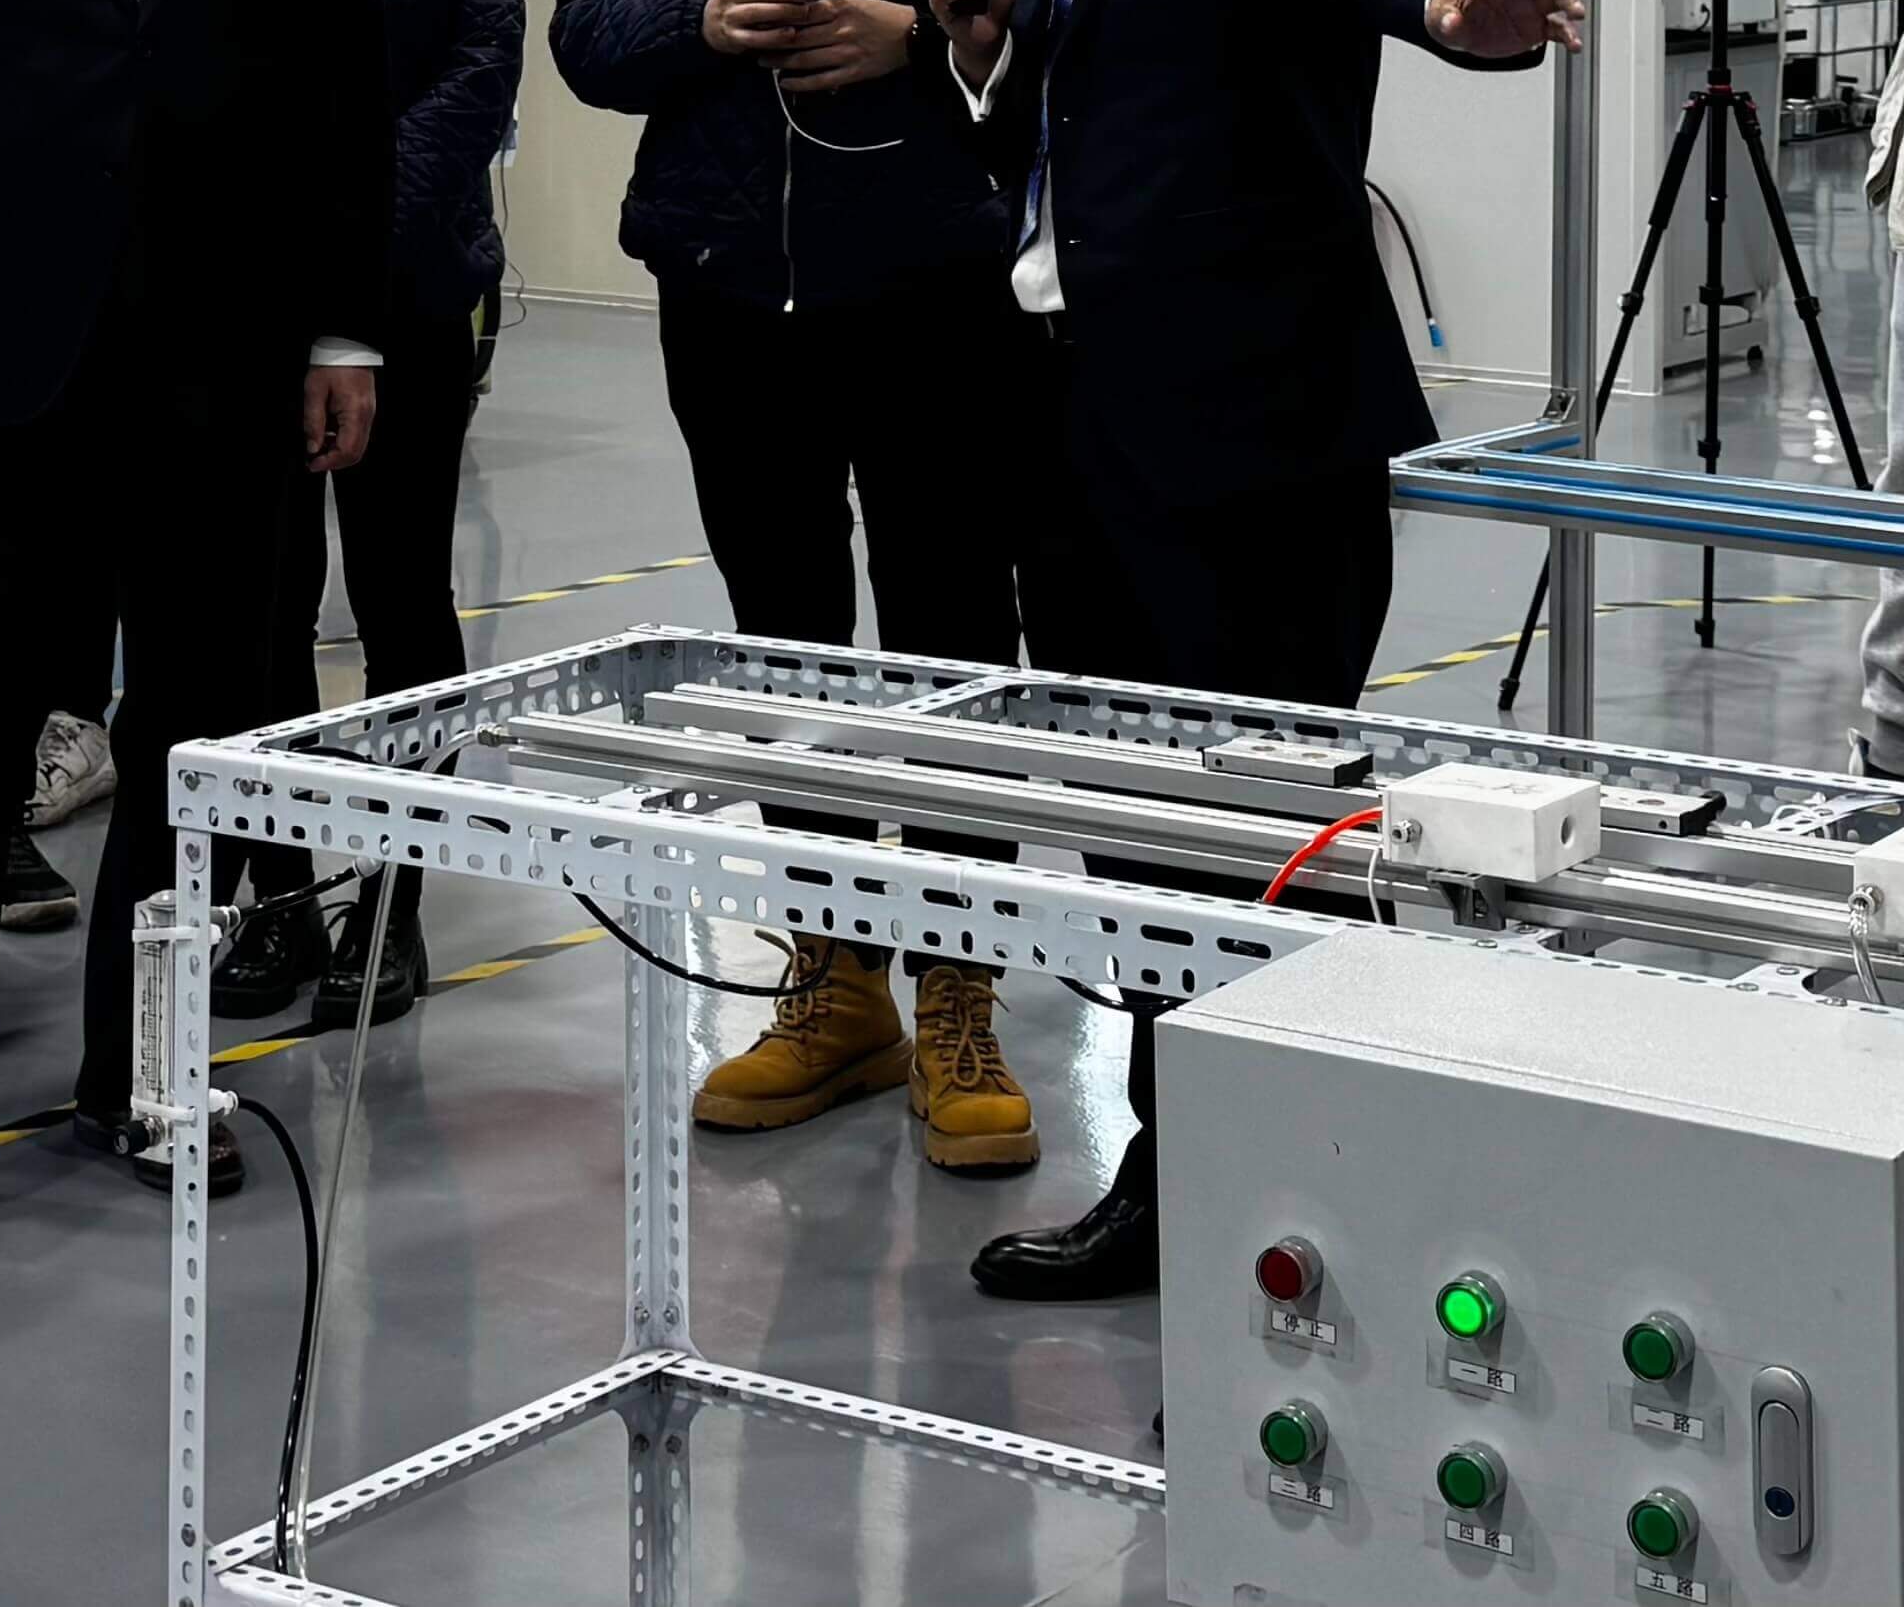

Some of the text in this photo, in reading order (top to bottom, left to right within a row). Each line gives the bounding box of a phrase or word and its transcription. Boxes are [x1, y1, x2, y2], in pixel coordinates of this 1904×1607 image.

[1283, 1313, 1325, 1339] 停止
[1461, 1366, 1504, 1387] 一路
[1646, 1409, 1691, 1434] 二路
[1280, 1478, 1322, 1504] 三路
[1458, 1522, 1501, 1549] 四路
[1650, 1571, 1694, 1596] 五路
